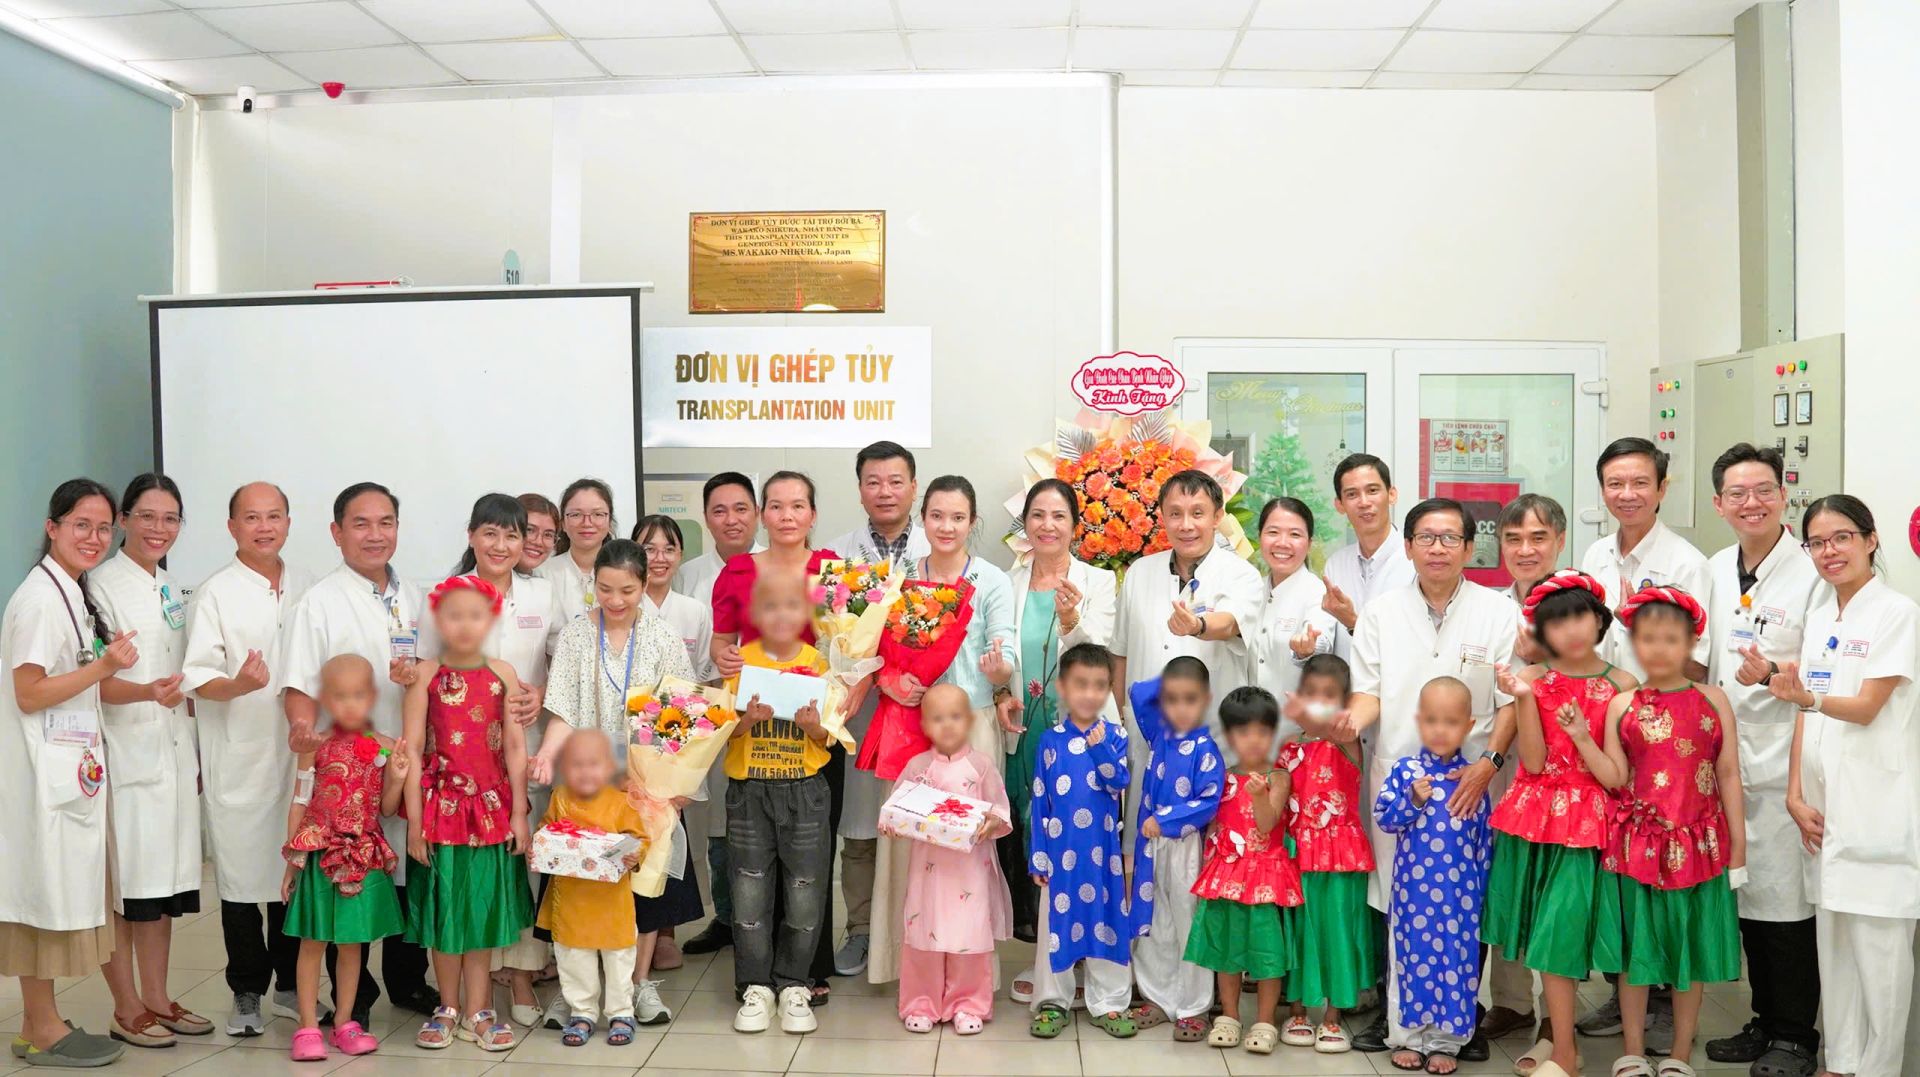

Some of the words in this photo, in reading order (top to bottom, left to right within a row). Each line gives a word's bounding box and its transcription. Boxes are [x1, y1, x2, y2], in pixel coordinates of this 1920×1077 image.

[824, 248, 851, 257] Japan
[675, 351, 728, 383] ĐƠN
[736, 354, 760, 388] VỊ
[769, 348, 836, 383] GHÉP
[845, 344, 894, 383] TỦY
[1130, 389, 1166, 407] Tặng
[677, 399, 846, 421] TRANSPLANTATION
[853, 400, 896, 421] UNIT
